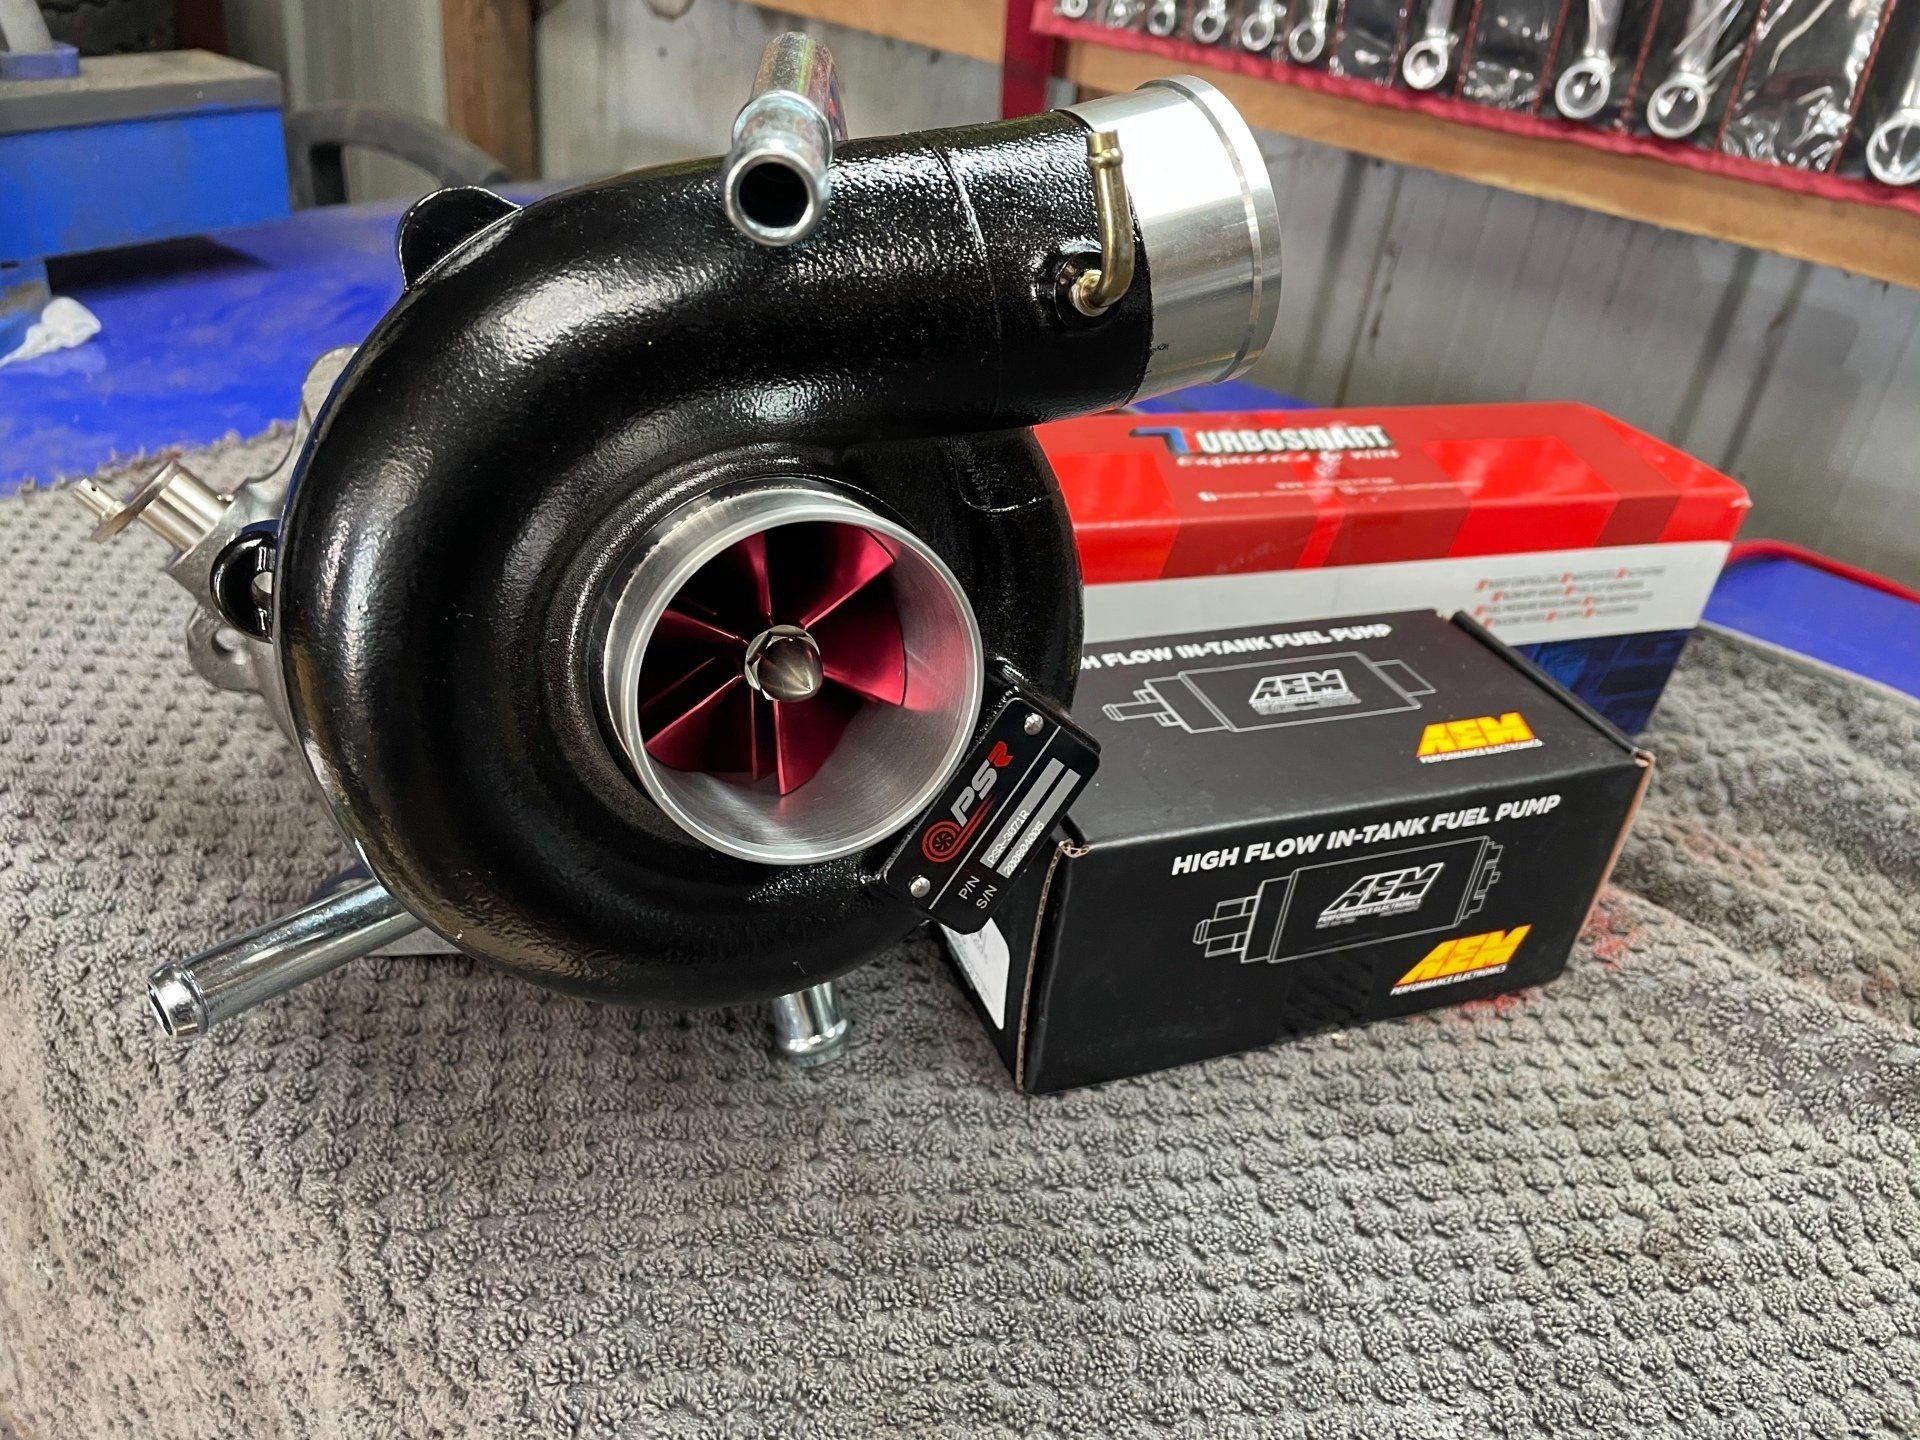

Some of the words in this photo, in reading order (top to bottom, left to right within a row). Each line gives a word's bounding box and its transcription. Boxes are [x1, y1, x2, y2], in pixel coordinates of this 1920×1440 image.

[1129, 425, 1391, 455] TURBOSMART
[1101, 647, 1173, 667] FLOW
[1175, 635, 1273, 659] IN-TANK
[1270, 630, 1332, 648] FUEL
[1329, 623, 1392, 642] PUMP
[1248, 668, 1349, 705] AEM
[1416, 711, 1535, 758] AEM
[950, 740, 1014, 828] PSR
[958, 875, 980, 900] P/N
[986, 809, 1031, 865] PSR-3071R
[1171, 847, 1240, 876] HIGH
[1244, 833, 1324, 863] FLOW
[1326, 816, 1430, 850] IN-TANK
[1431, 806, 1490, 832] FUEL
[1495, 794, 1562, 822] PUMP
[976, 884, 998, 909] S/N
[1320, 861, 1445, 915] AEM
[1393, 923, 1532, 987] AEM
[1389, 975, 1454, 996] PERFORMANCE
[1453, 963, 1507, 983] ELECTRONICS
